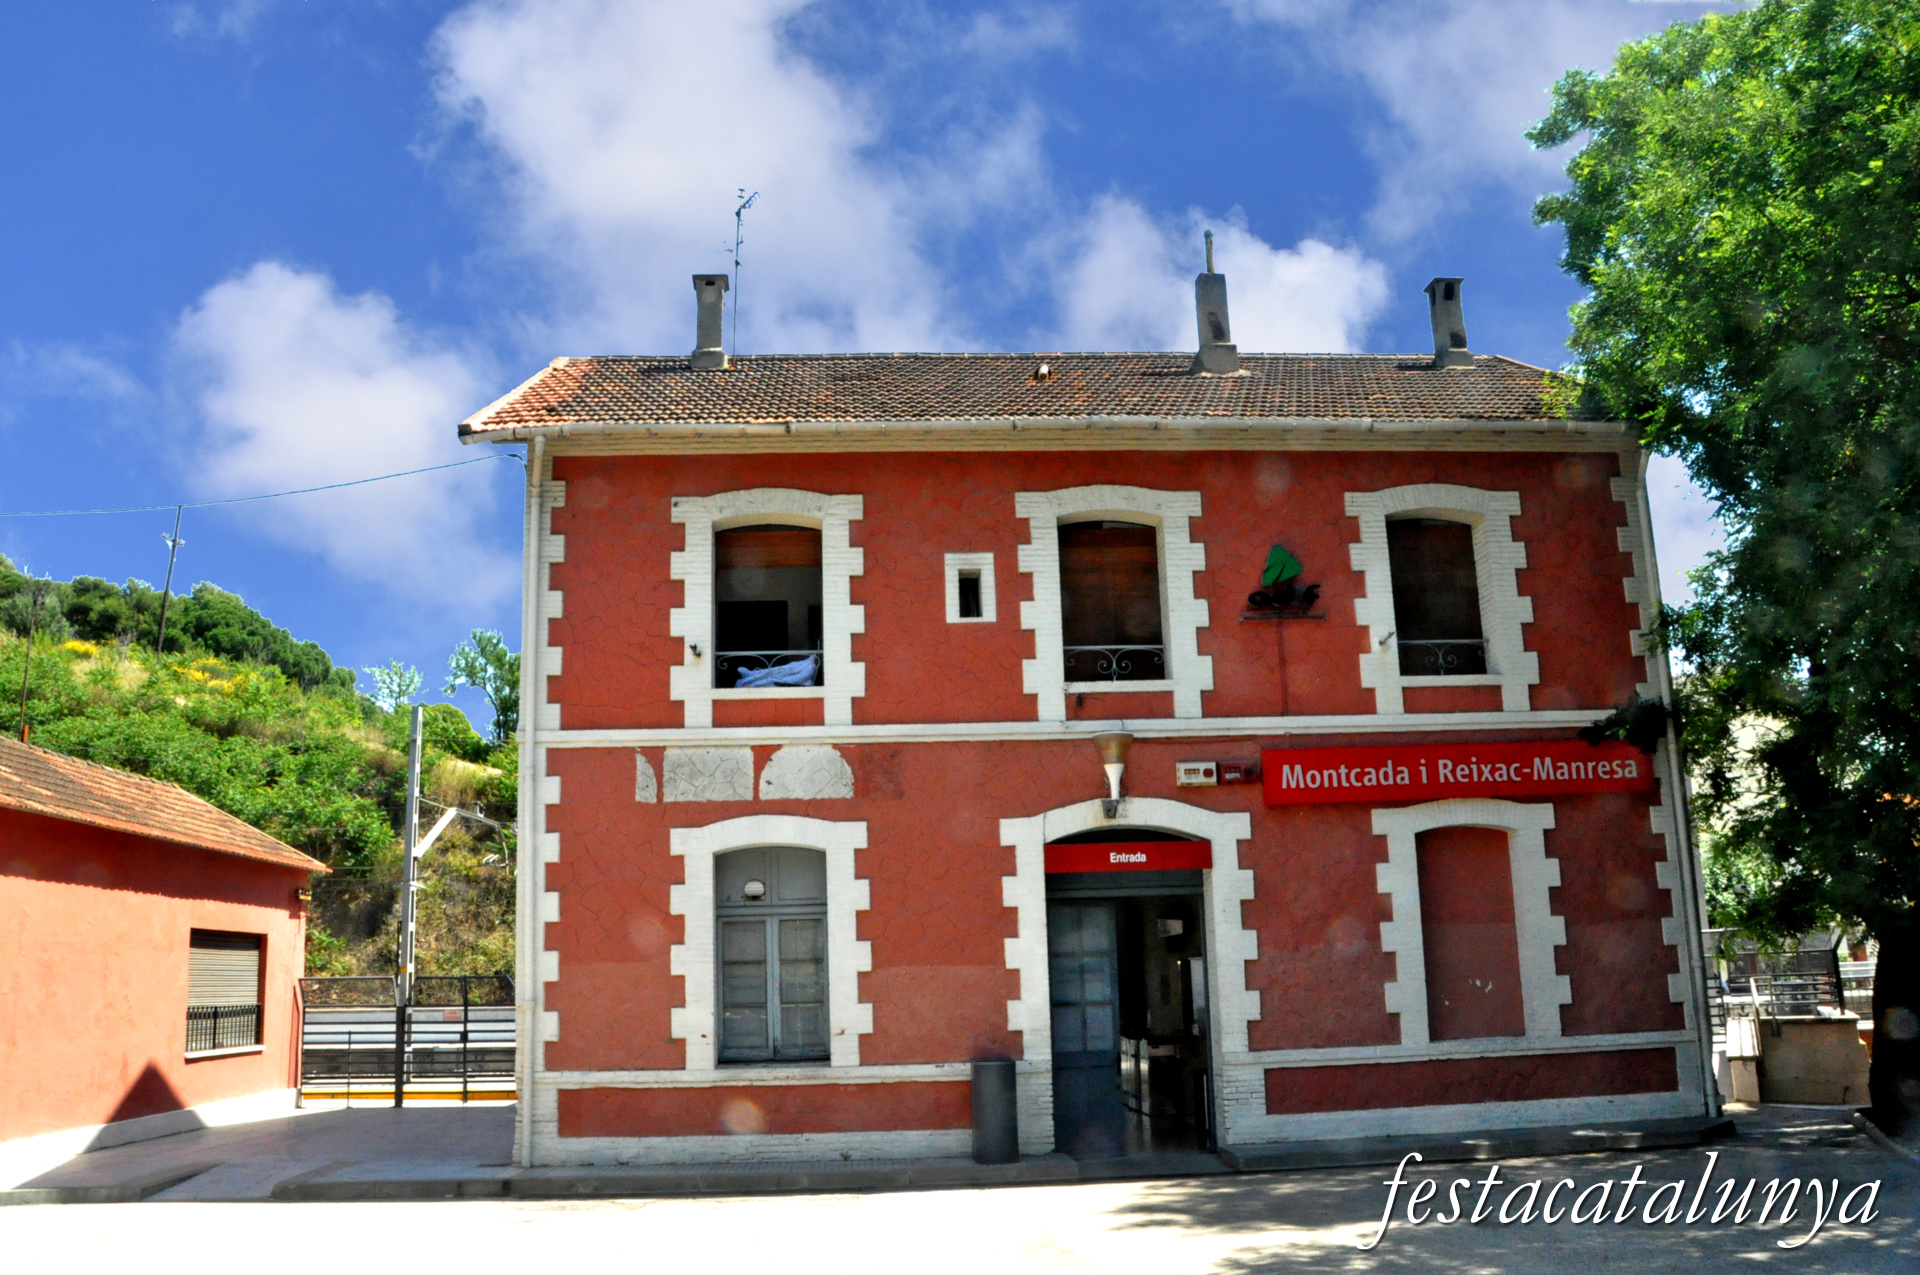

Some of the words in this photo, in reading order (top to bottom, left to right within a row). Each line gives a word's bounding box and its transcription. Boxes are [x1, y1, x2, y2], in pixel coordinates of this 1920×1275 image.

[1281, 759, 1410, 789] Montcada
[1418, 758, 1428, 784] i
[1438, 756, 1638, 784] Reixac-Manresa
[1109, 851, 1147, 864] Entrada
